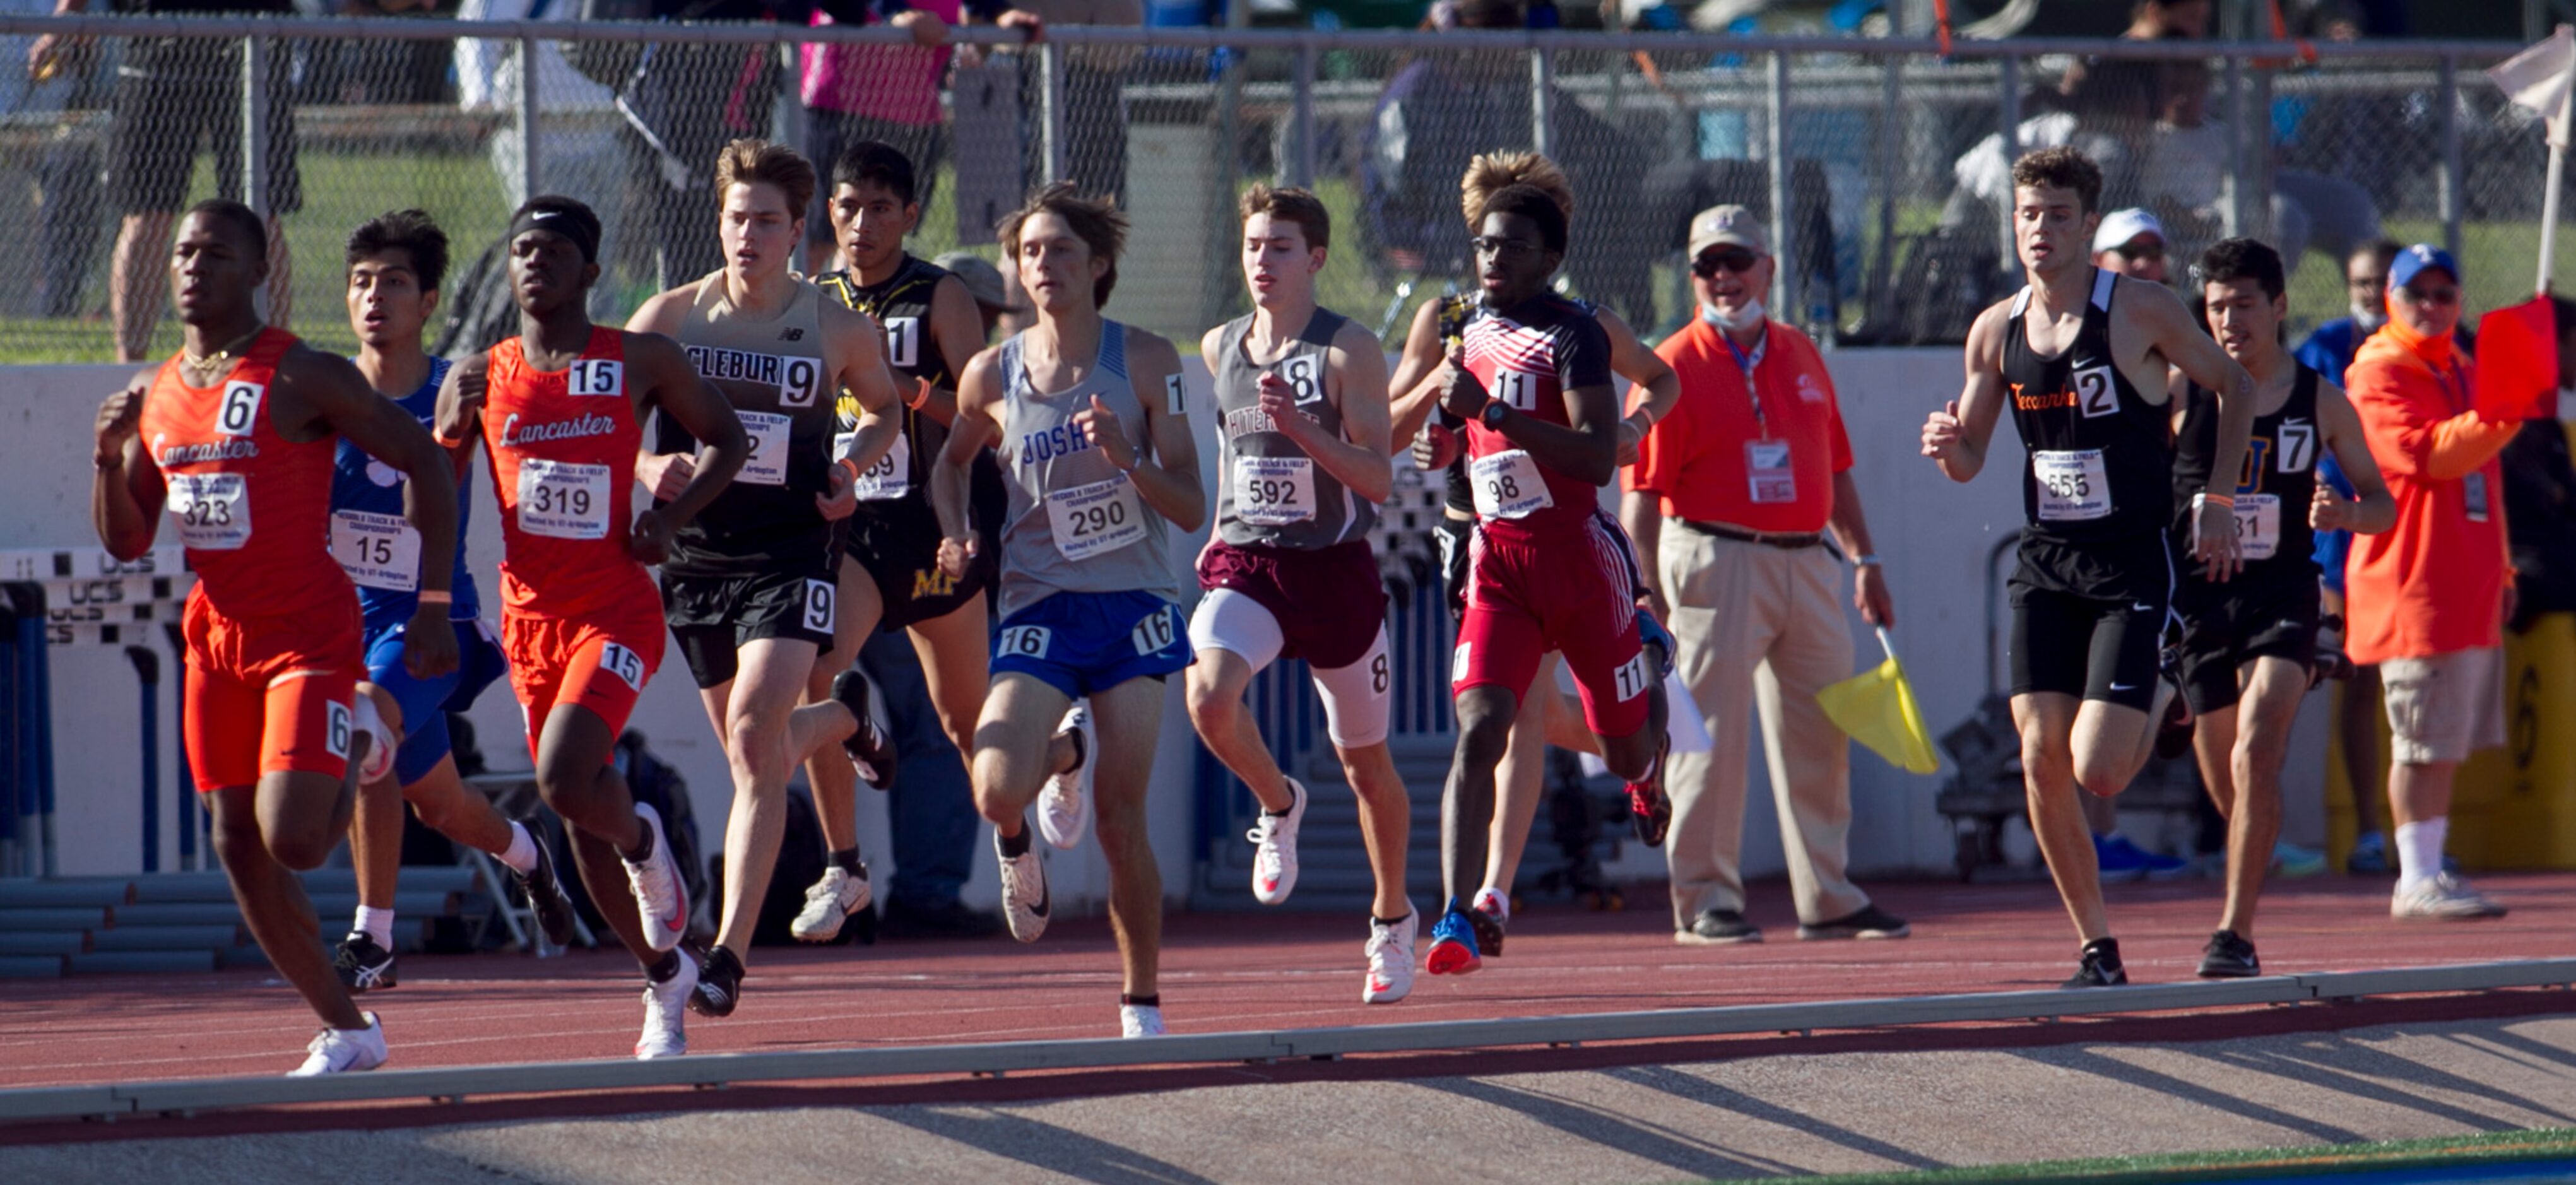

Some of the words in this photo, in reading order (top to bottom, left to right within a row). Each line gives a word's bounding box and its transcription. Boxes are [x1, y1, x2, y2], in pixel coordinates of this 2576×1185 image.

[574, 362, 613, 392] 15
[787, 360, 815, 403] 9
[1290, 360, 1314, 401] 8
[1498, 372, 1524, 407] 11
[2081, 373, 2113, 413] 2
[224, 386, 254, 430] 6
[500, 412, 616, 447] Lancaster
[1022, 421, 1100, 464] JOSH
[2284, 430, 2308, 469] 7
[535, 485, 590, 516] 319
[1250, 480, 1297, 504] 592
[1489, 475, 1520, 504] 98
[184, 500, 230, 526] 323
[1069, 500, 1125, 536] 290
[357, 536, 392, 565] 15
[69, 579, 124, 604] UCS
[810, 584, 830, 628] 9
[1006, 627, 1043, 654] 16
[1137, 609, 1171, 649] 16
[607, 646, 639, 684] 15
[1371, 652, 1388, 694] 8
[1619, 657, 1642, 698] 11
[333, 707, 348, 754] 6
